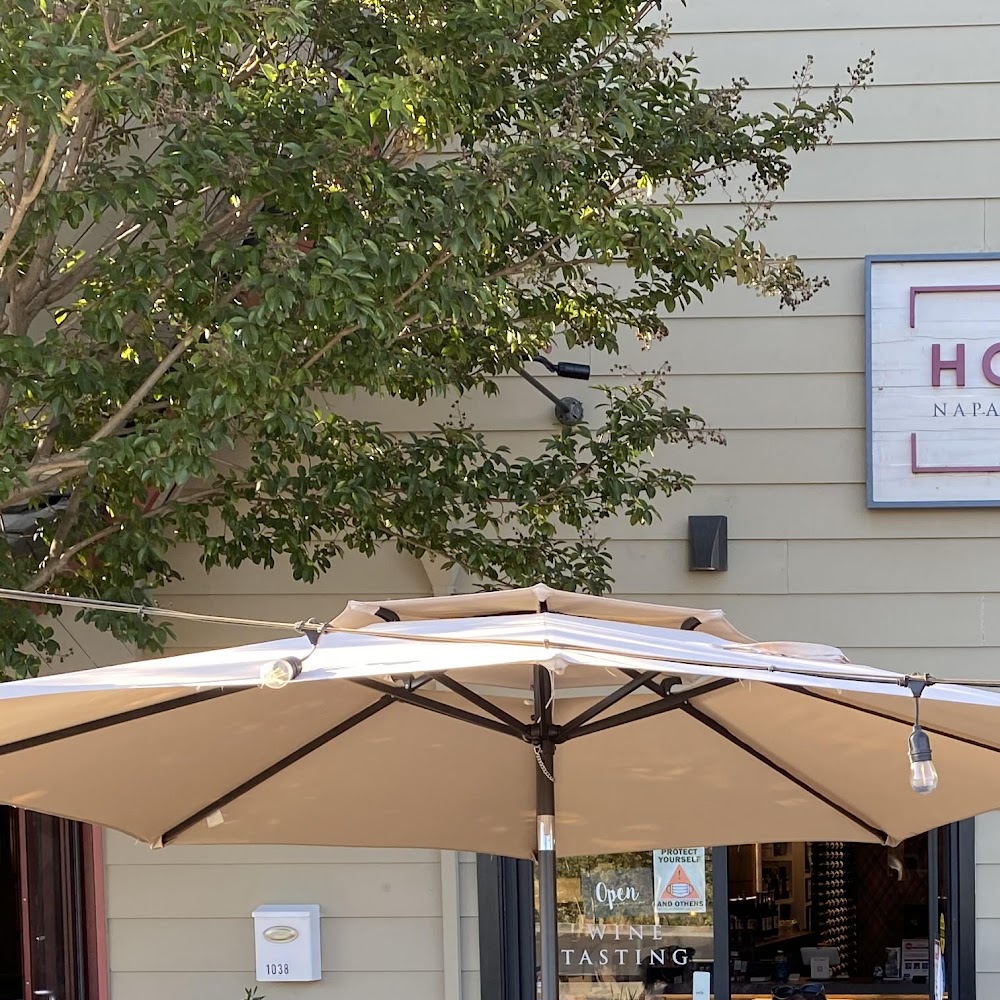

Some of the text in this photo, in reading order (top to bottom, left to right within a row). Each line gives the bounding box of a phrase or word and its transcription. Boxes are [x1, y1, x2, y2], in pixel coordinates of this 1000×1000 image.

[933, 402, 999, 417] NAPA
[658, 855, 701, 863] YOURSELF
[596, 881, 640, 910] Open
[587, 924, 663, 940] WINE
[561, 949, 689, 966] TASTING
[266, 963, 289, 975] 1038
